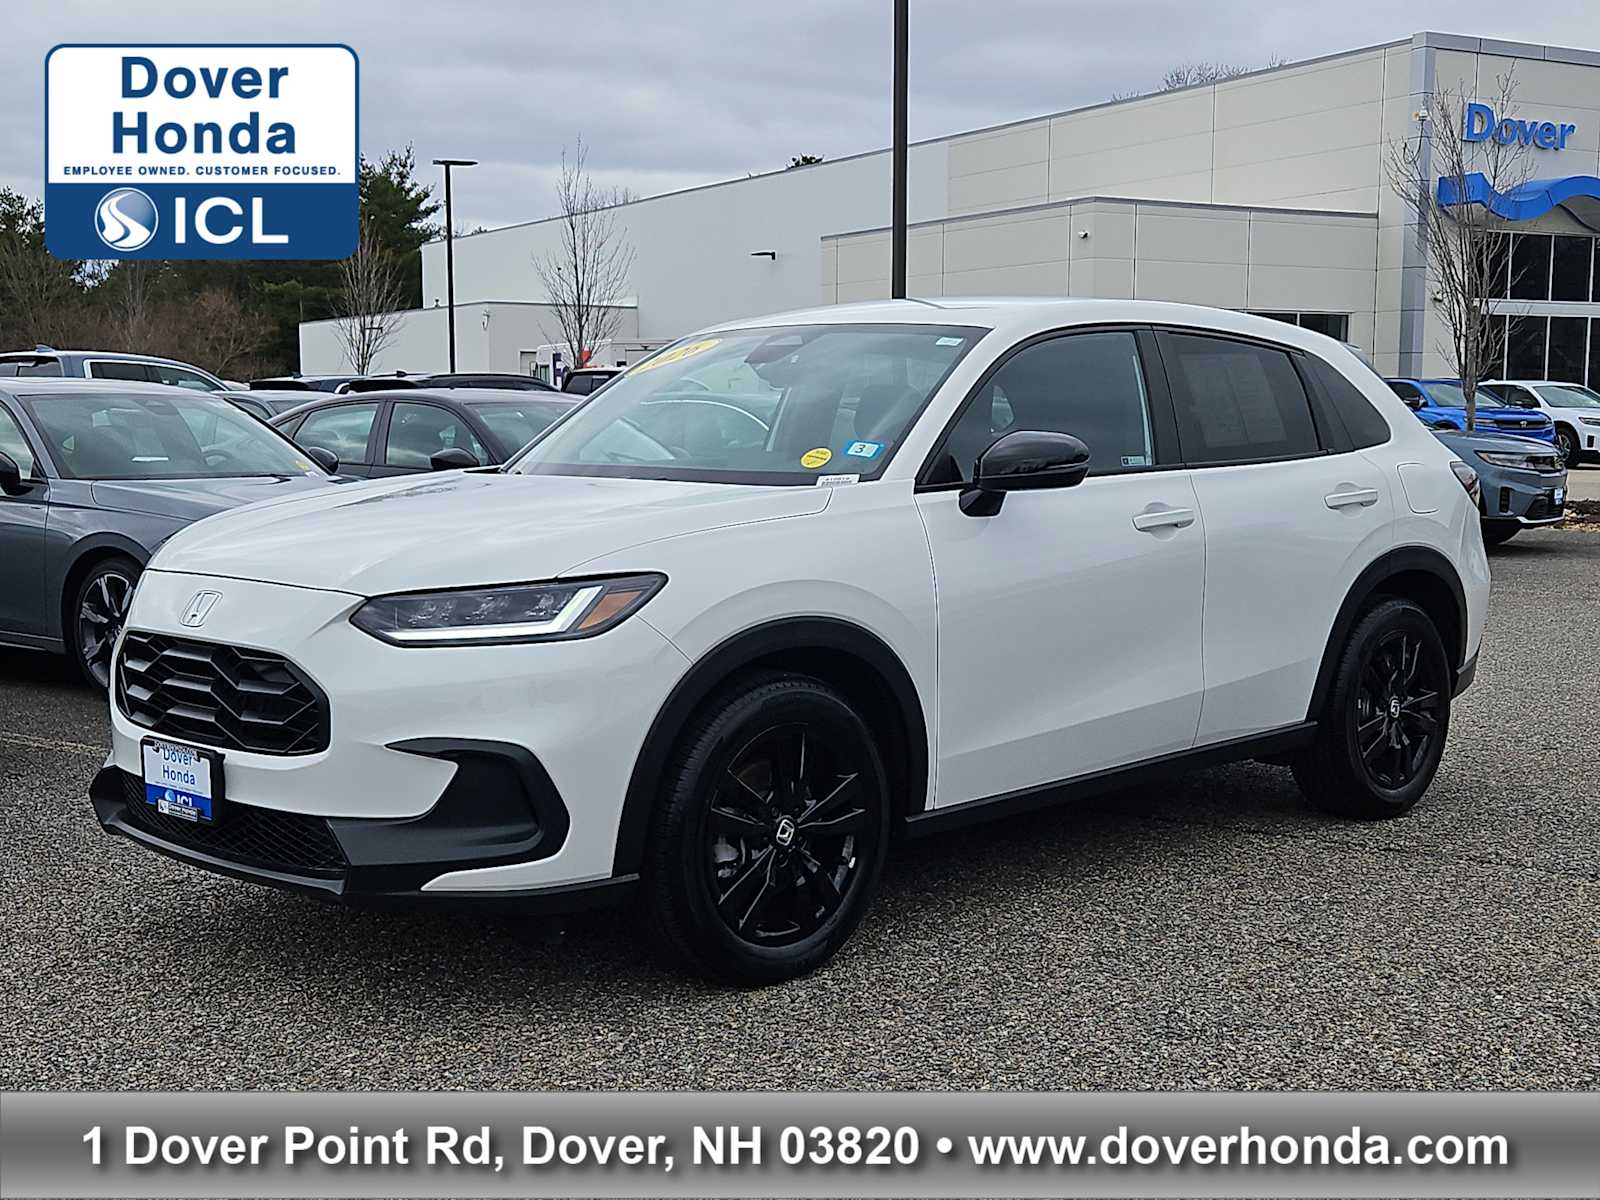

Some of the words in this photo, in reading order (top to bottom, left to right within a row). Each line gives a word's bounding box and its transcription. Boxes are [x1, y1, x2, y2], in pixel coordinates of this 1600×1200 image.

[1465, 102, 1576, 150] Dover
[163, 748, 193, 766] Dover
[162, 764, 196, 785] Honda
